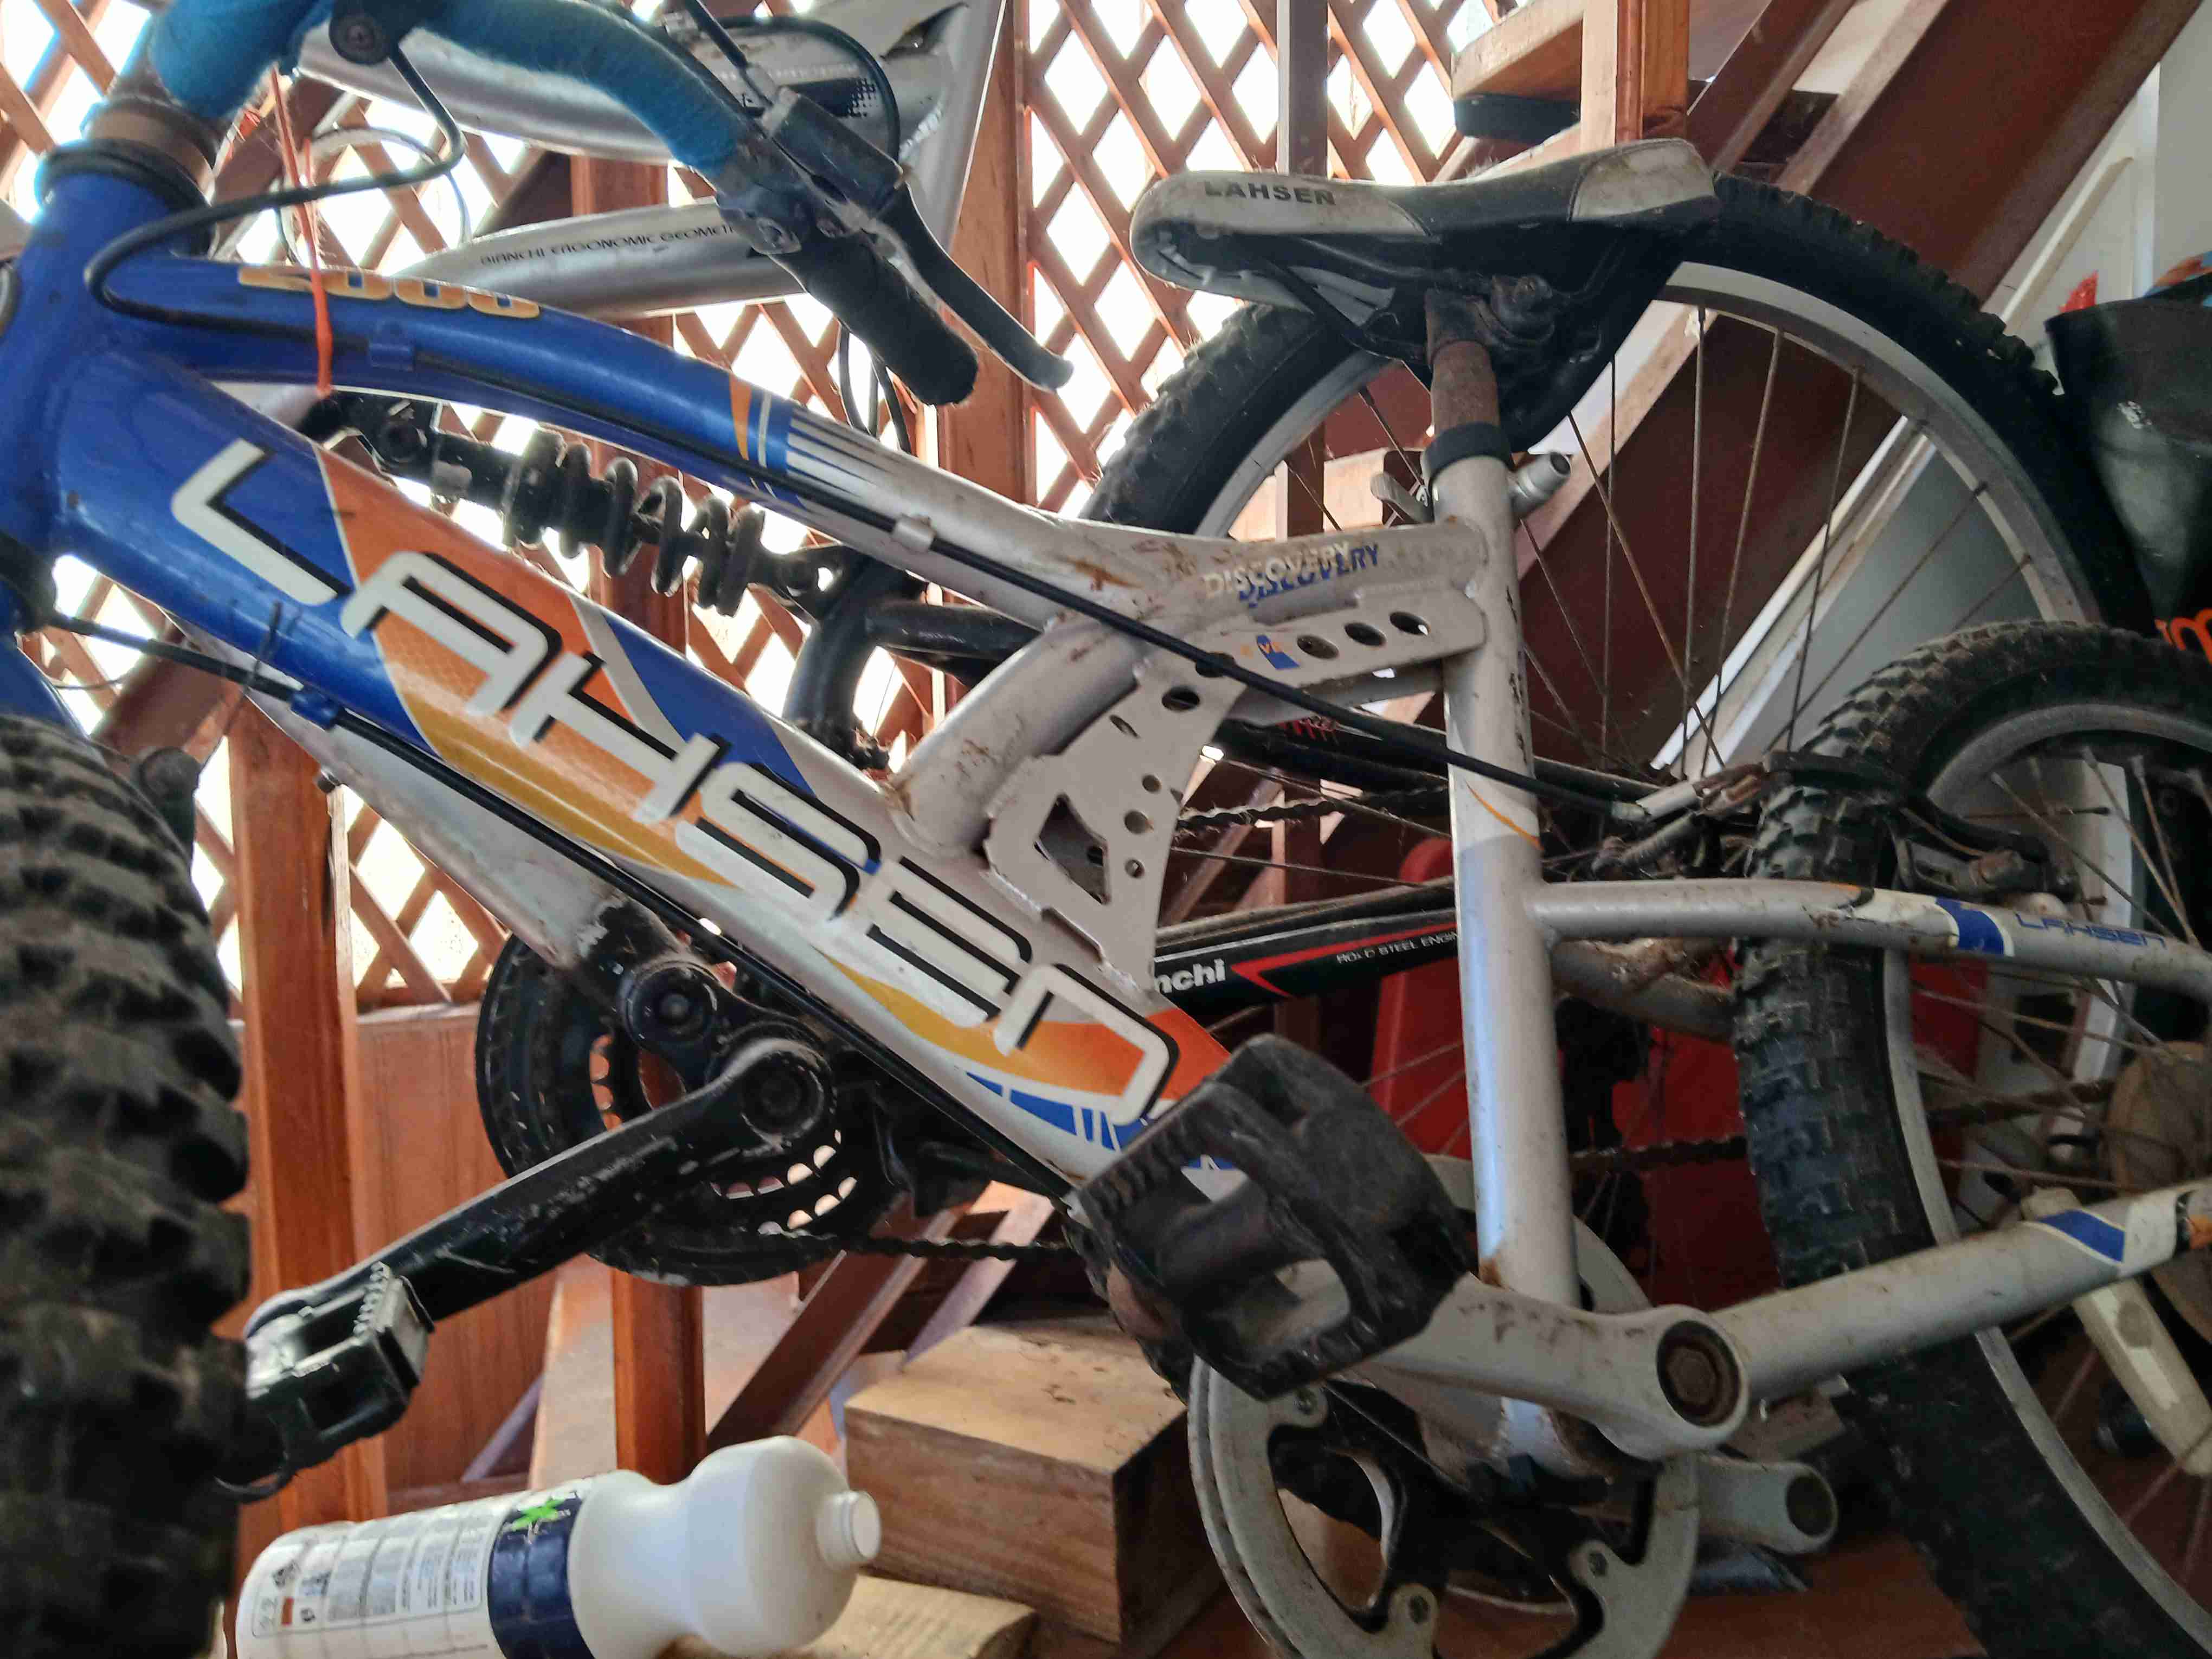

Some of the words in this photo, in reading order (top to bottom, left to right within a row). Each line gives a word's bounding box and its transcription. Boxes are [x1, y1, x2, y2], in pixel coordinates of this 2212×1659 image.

[1204, 180, 1336, 205] LAHSEN
[170, 437, 1181, 1127] LAHSEN
[2015, 911, 2166, 948] LAHSEN
[1378, 938, 1419, 956] STEEL
